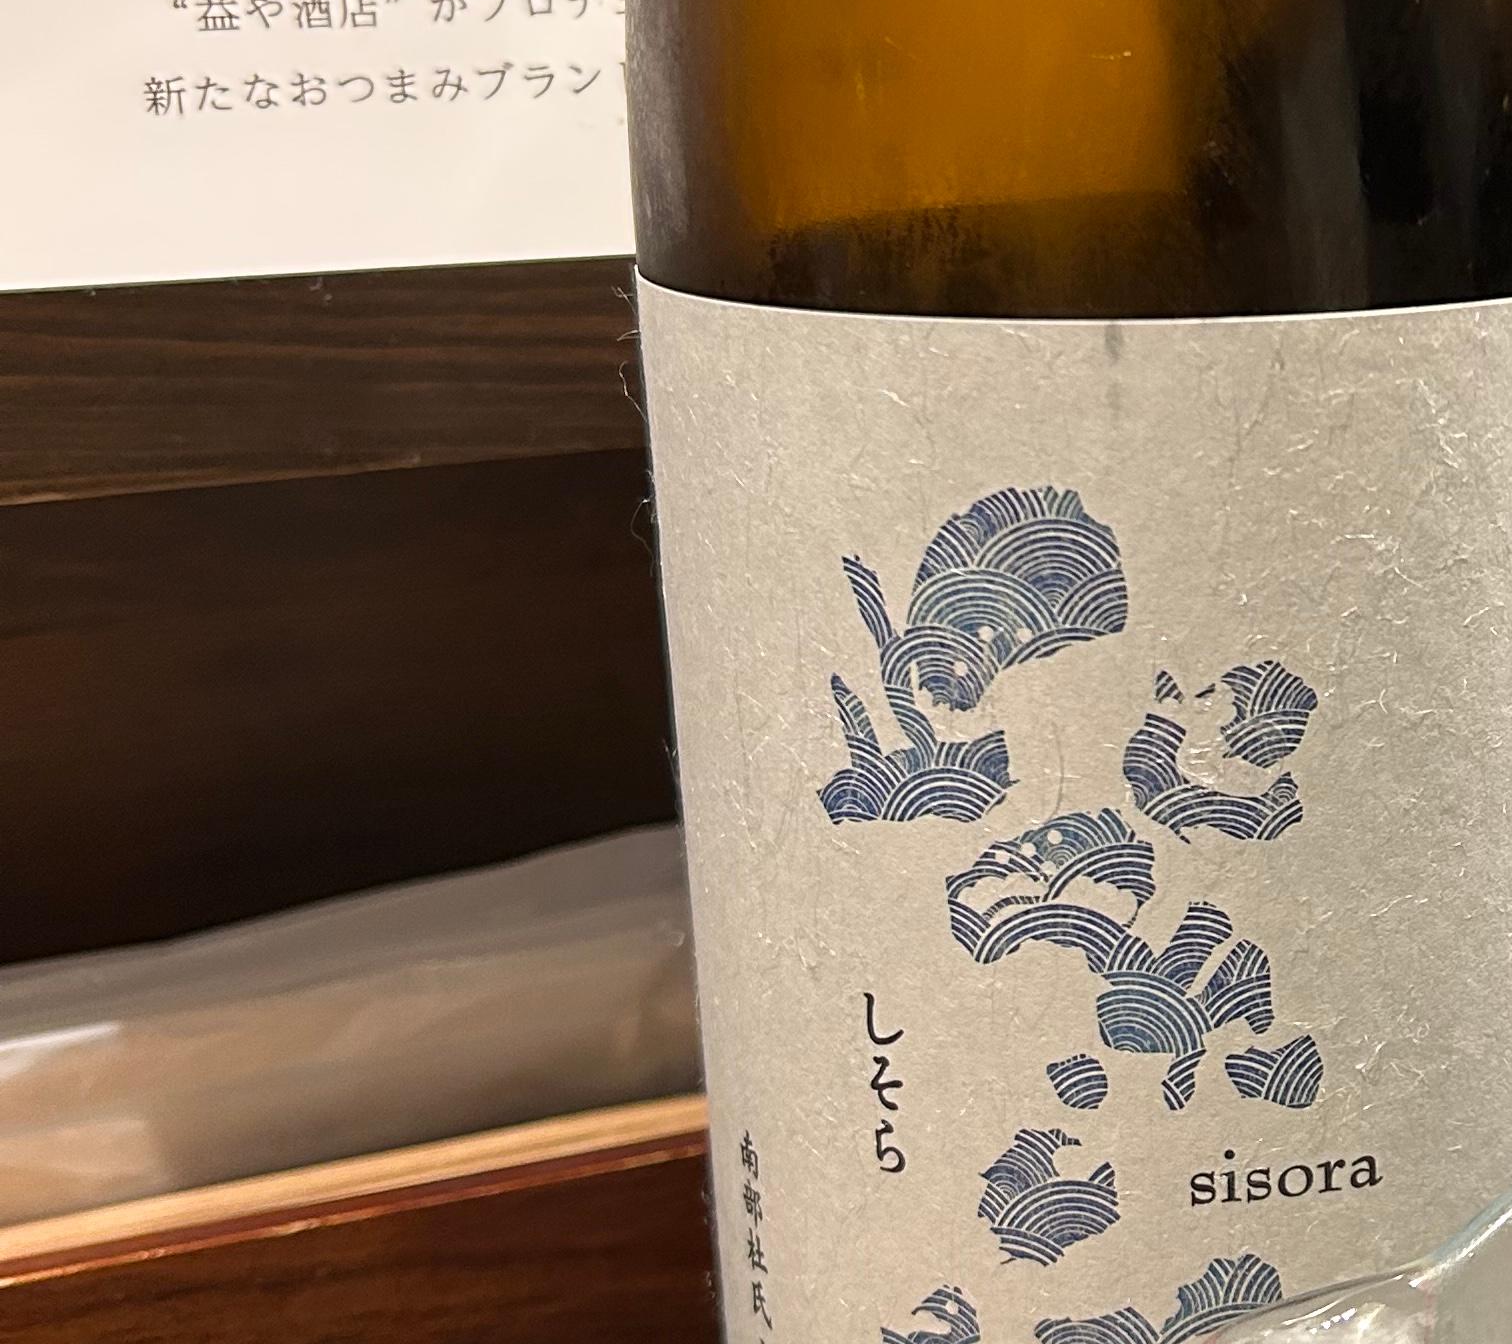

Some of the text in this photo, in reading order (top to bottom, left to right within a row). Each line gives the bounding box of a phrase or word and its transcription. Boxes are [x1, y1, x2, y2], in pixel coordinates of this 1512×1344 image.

[862, 991, 908, 1174] しそら
[1188, 1148, 1384, 1208] sisora
